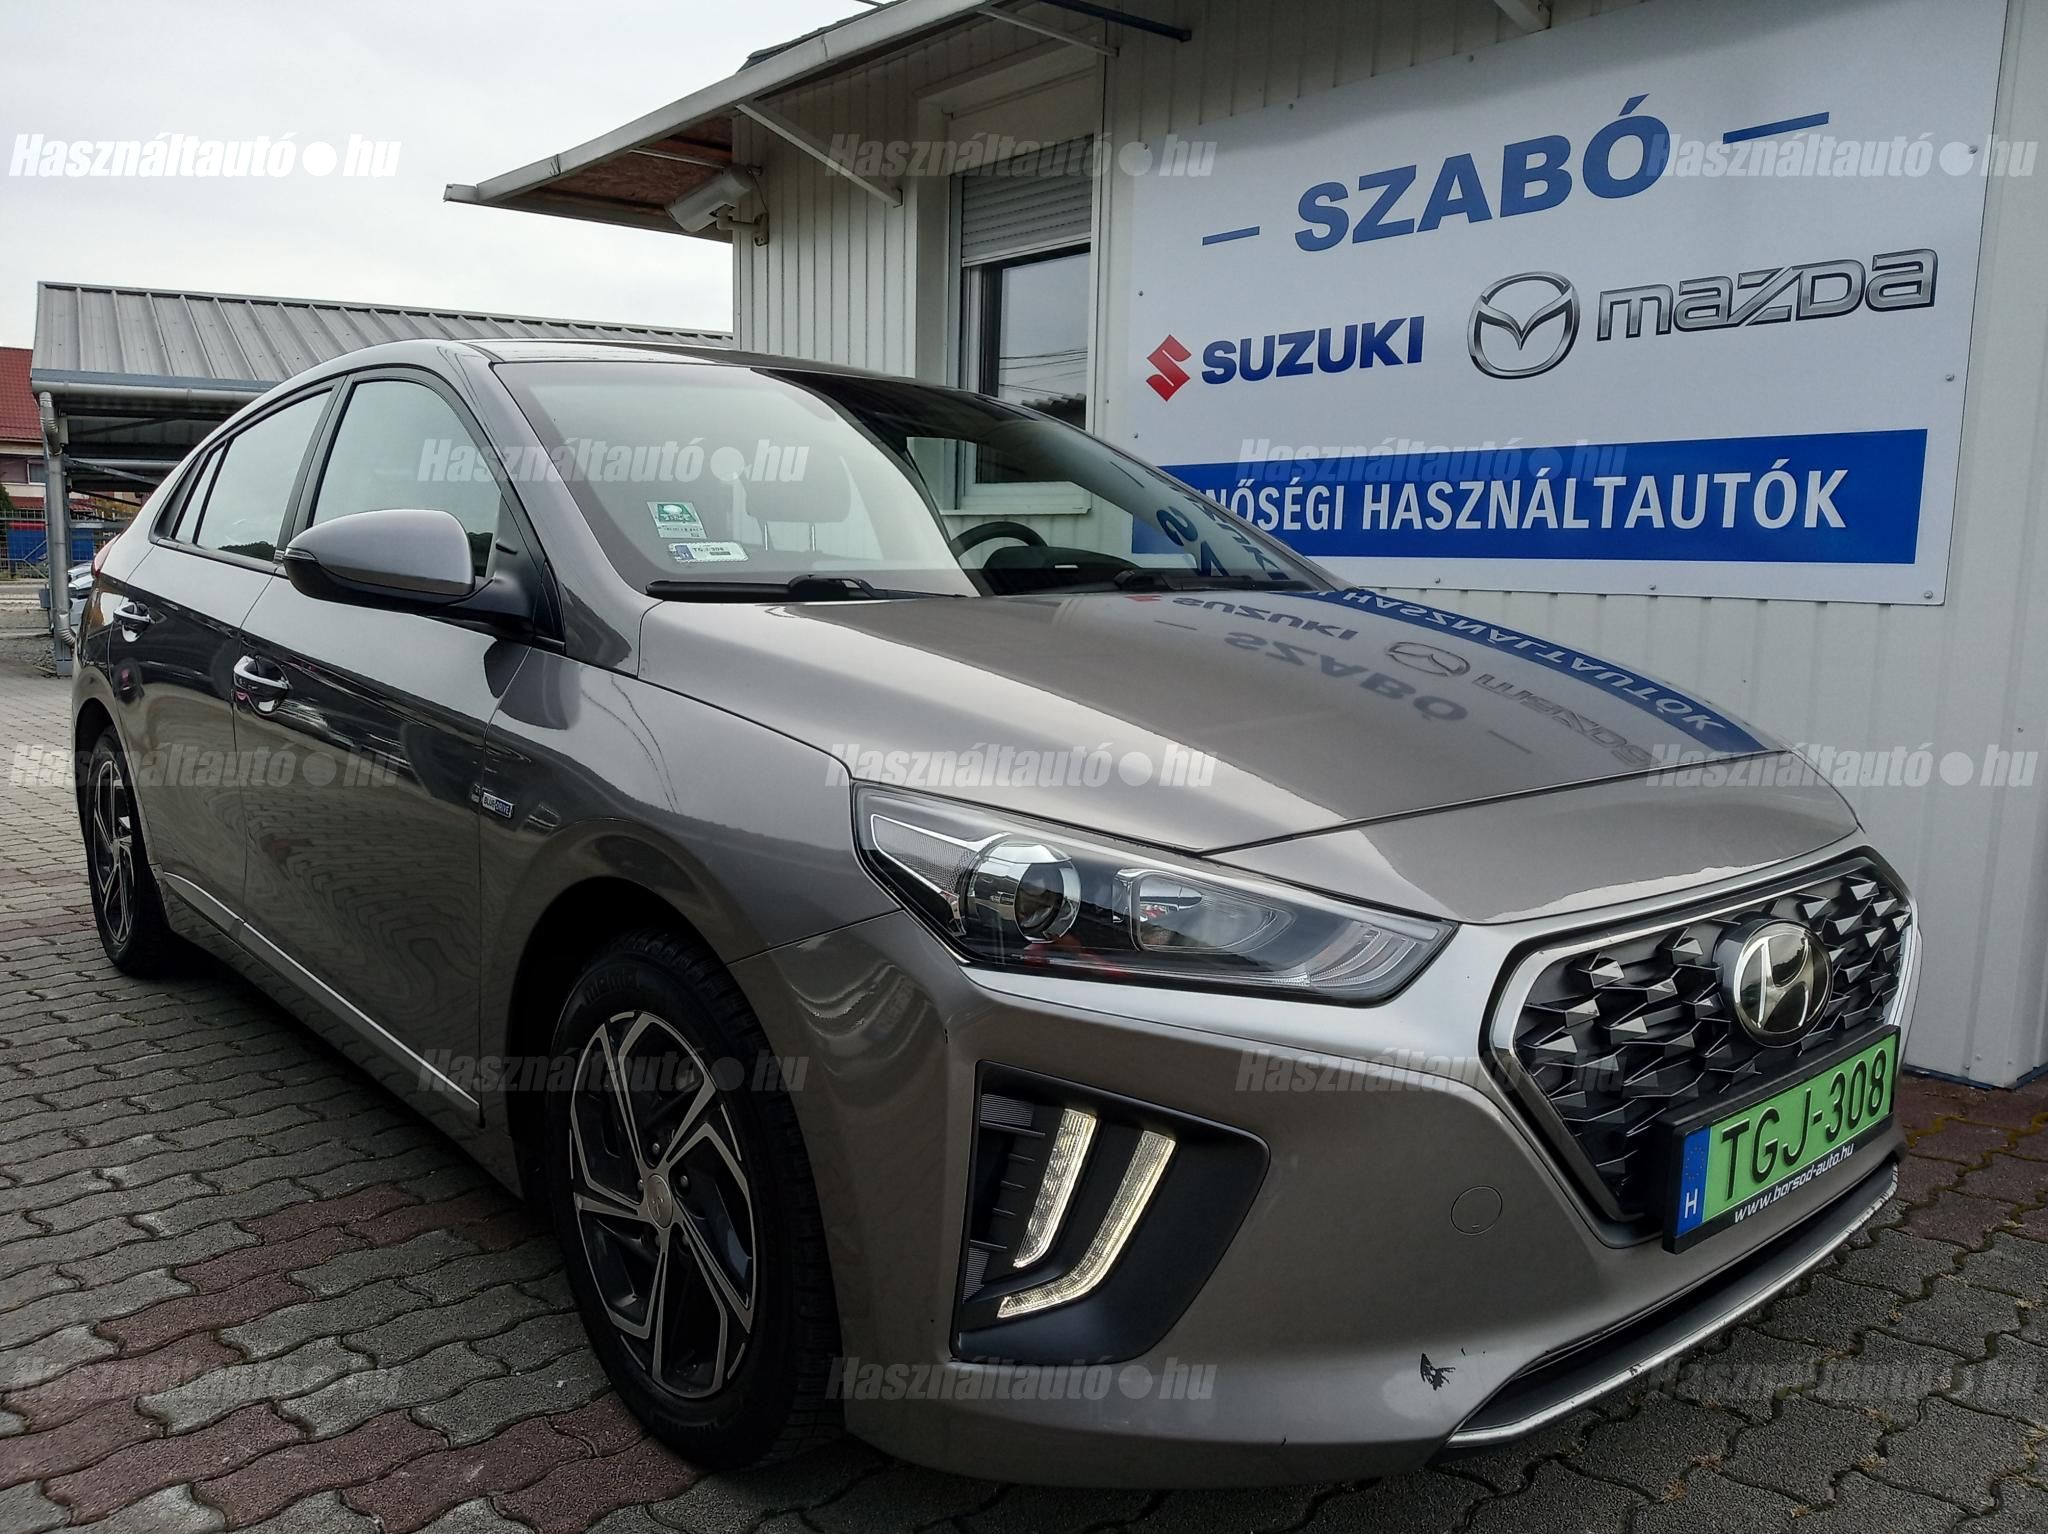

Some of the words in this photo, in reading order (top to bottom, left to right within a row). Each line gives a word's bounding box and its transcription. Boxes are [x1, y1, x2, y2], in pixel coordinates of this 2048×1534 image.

[1294, 93, 1671, 252] SZABÓ
[1200, 316, 1424, 385] SUZUKI
[1364, 458, 1848, 531] HASZNÁLTAUTÓK
[1721, 1047, 1888, 1201] TGJ-308
[1684, 1188, 1698, 1219] H
[1734, 1143, 1855, 1224] www.borsod-auto.hu
